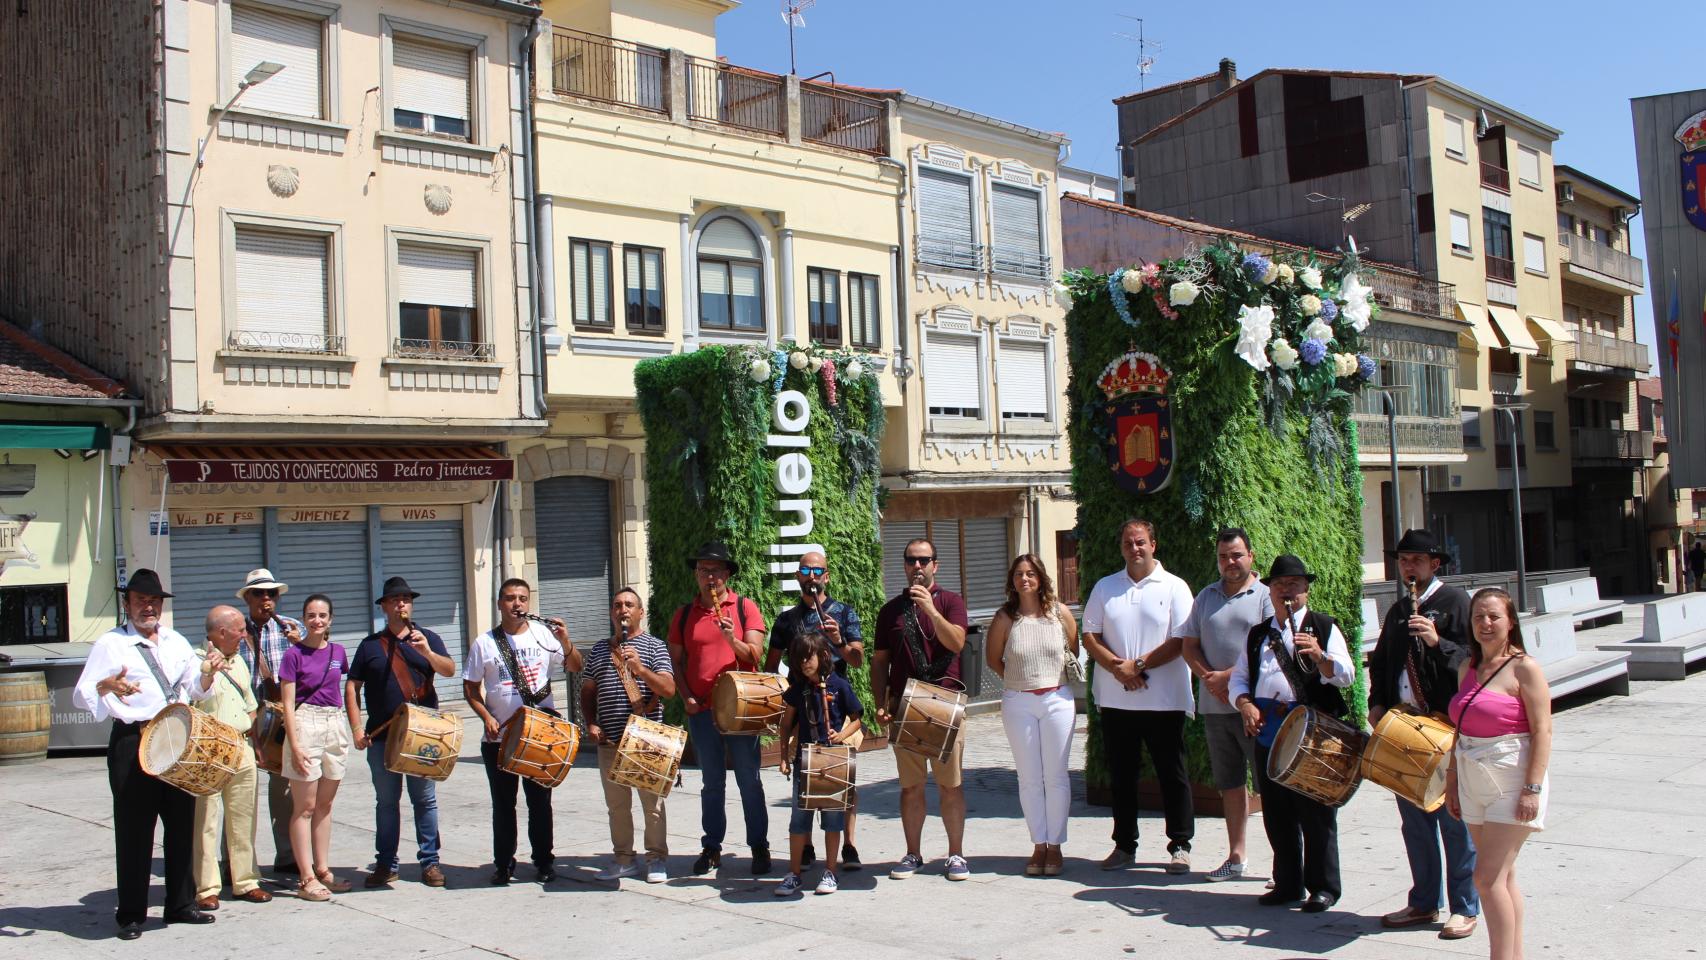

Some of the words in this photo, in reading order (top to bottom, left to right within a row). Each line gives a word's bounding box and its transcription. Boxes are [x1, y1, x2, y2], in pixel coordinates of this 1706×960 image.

[231, 463, 280, 479] TEJIDOS
[282, 463, 290, 479] Y
[293, 463, 378, 479] CONFECCIONES
[394, 462, 433, 477] Pedro
[436, 463, 493, 480] Jiménez
[766, 390, 825, 614] ijuelo
[176, 513, 197, 525] Vda
[206, 512, 224, 524] DE
[291, 511, 349, 521] JIMENEZ
[402, 509, 436, 519] VIVAS
[51, 711, 95, 725] LHAMBR
